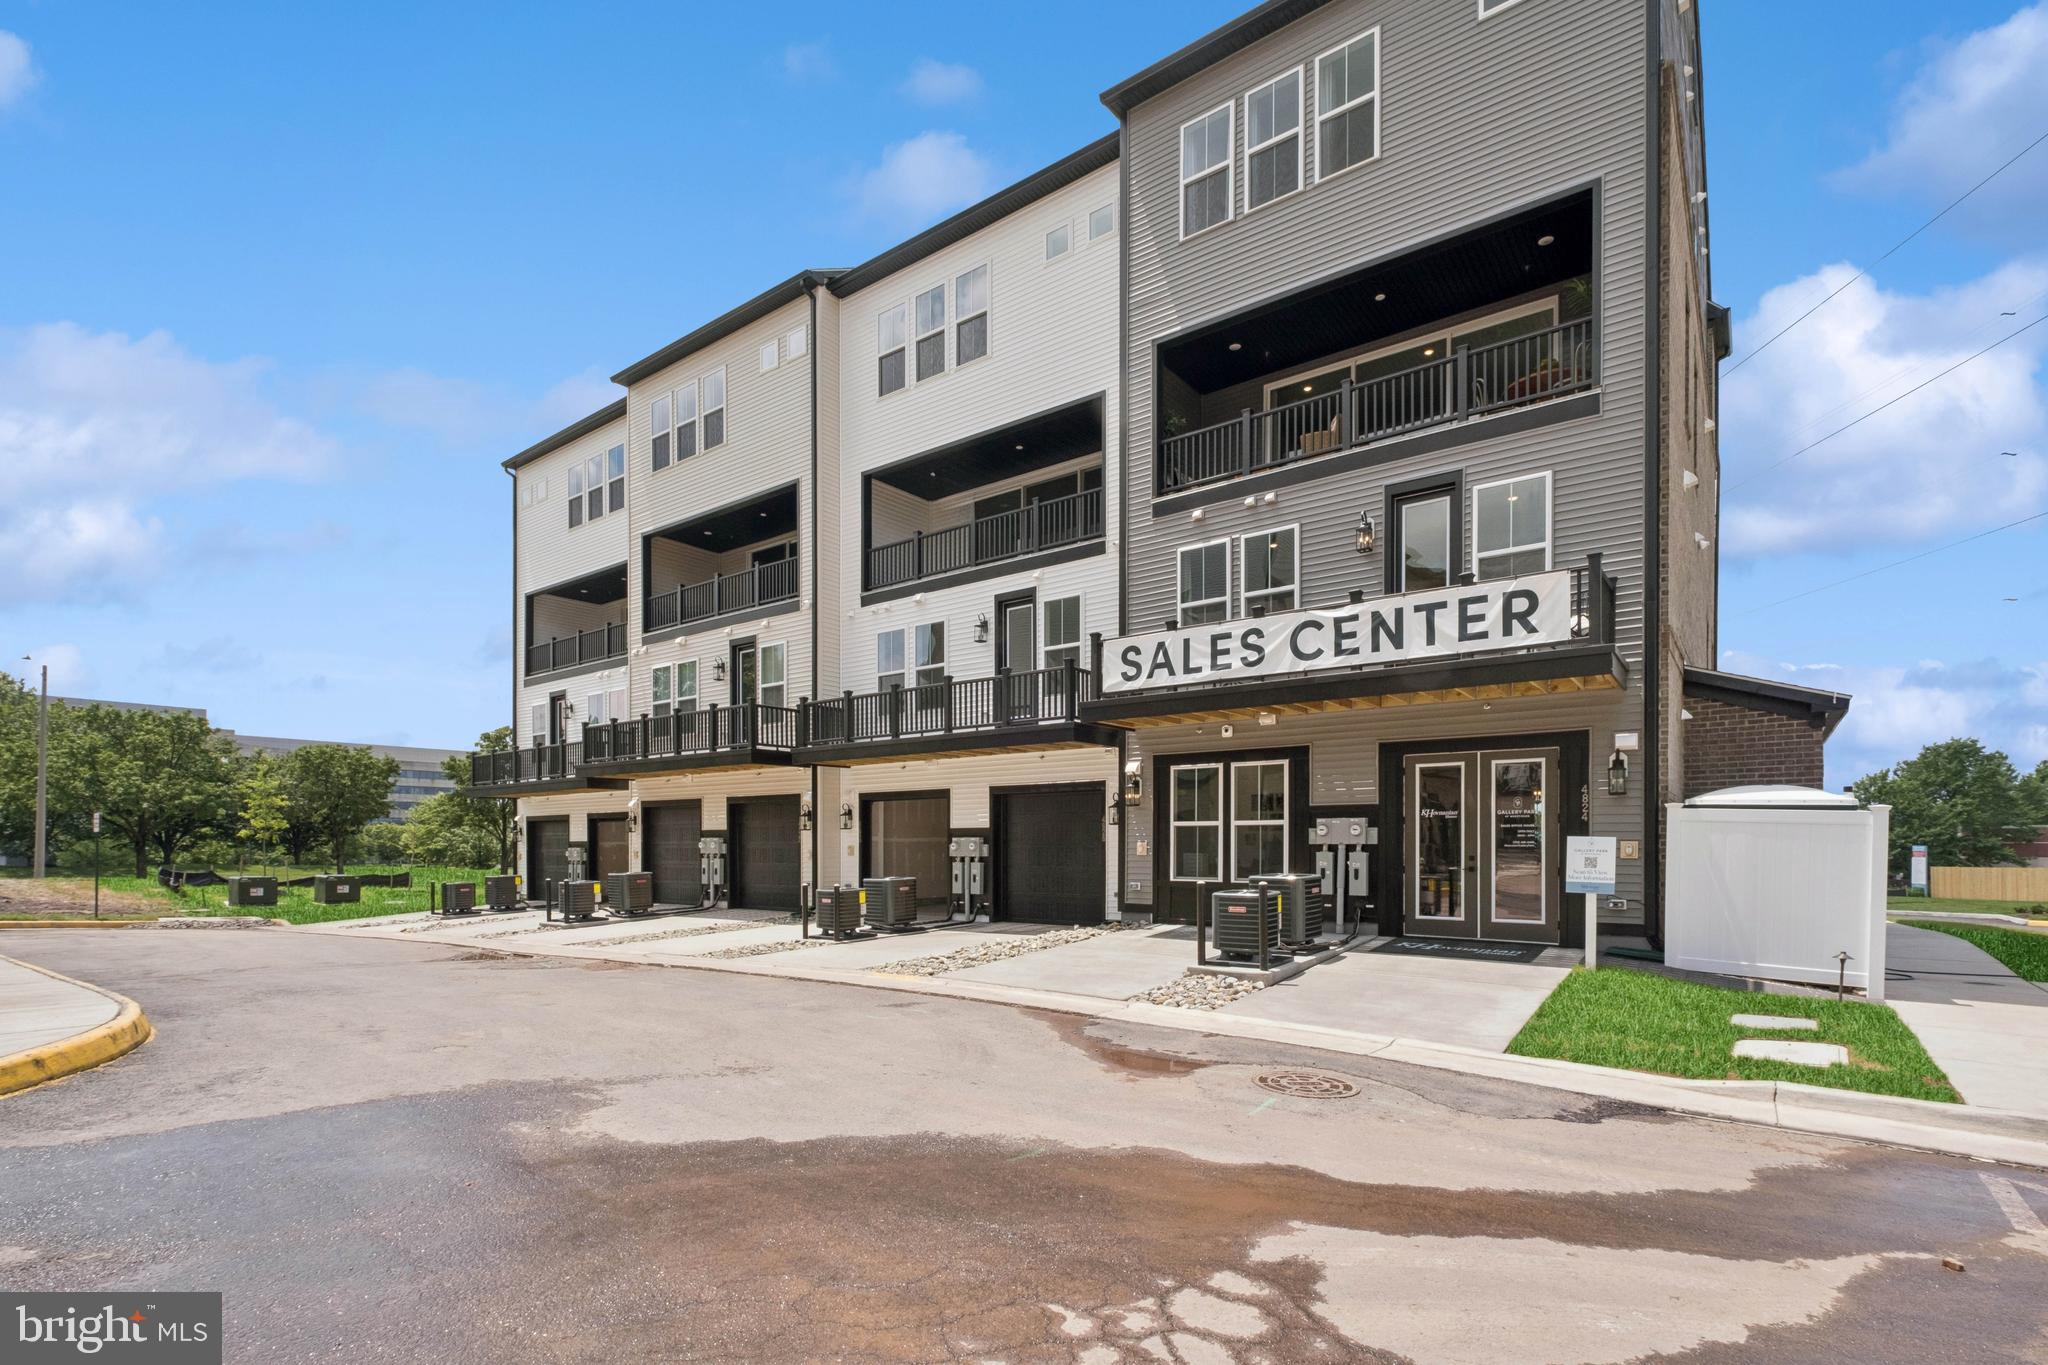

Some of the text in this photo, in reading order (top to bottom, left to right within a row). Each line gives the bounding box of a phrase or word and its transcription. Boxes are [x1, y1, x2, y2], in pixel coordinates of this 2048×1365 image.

[1120, 588, 1540, 682] SALES CENTER
[1581, 784, 1589, 822] 4824
